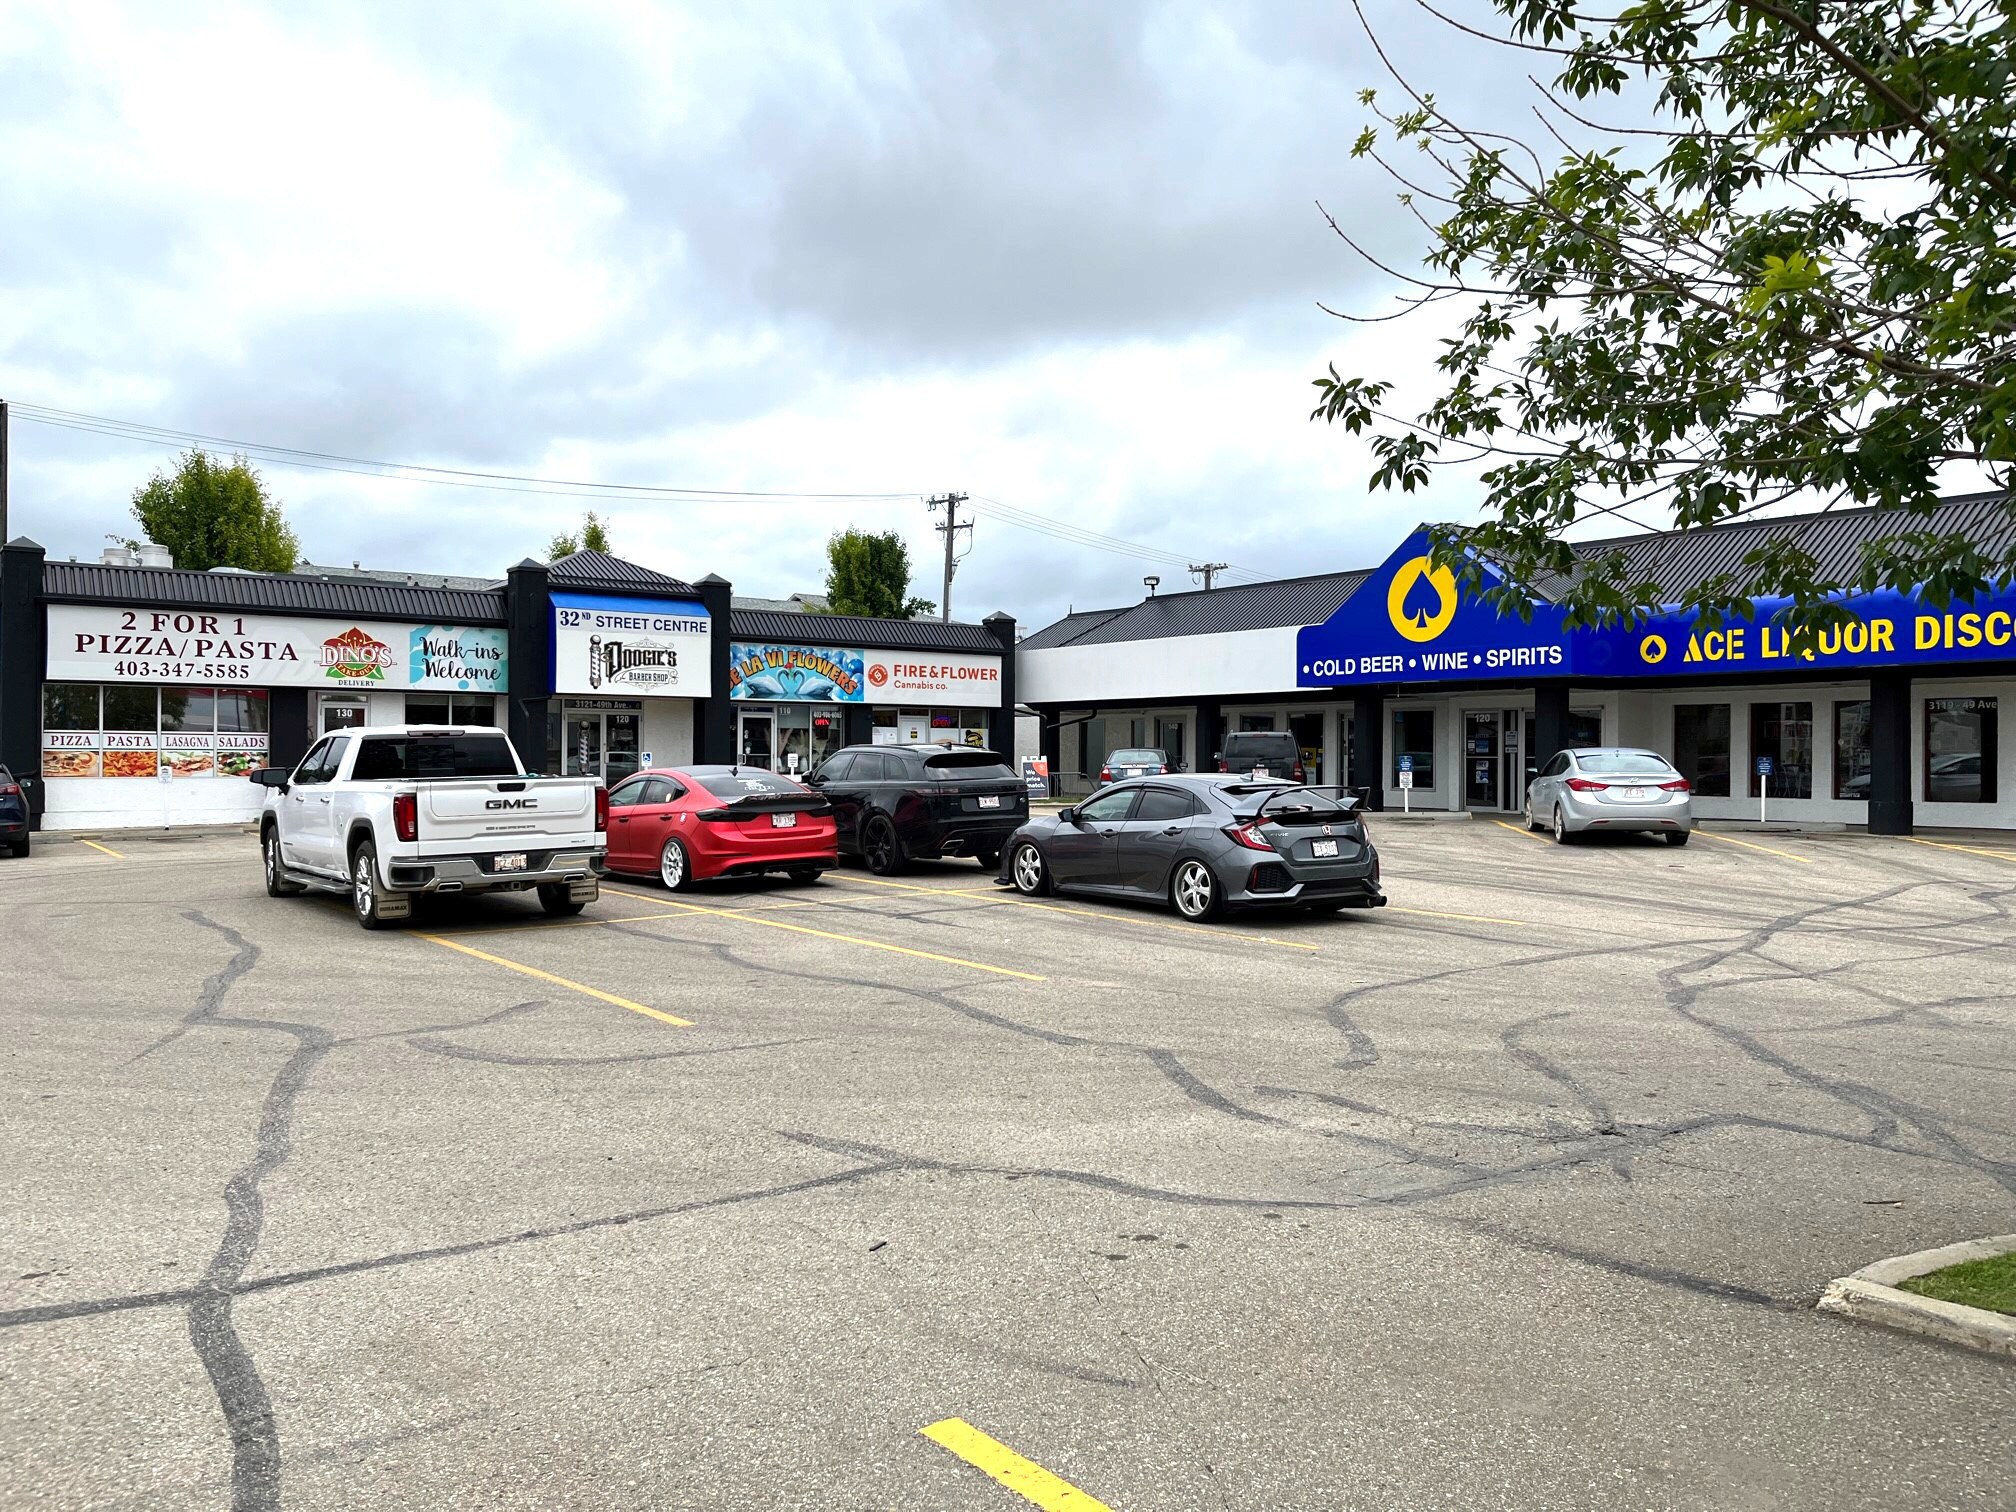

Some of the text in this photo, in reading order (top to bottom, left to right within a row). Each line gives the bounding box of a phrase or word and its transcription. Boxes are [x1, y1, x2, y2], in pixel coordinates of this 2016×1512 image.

[121, 611, 246, 636] 2 FOR 1
[596, 615, 650, 630] STREET
[653, 619, 708, 633] CENTRE
[1683, 627, 1745, 662] ACE
[1914, 611, 2016, 650] DISC
[75, 634, 299, 661] PIZZA/PASTA
[319, 644, 393, 668] DINO'S
[419, 636, 504, 660] Walk-ins
[421, 657, 502, 680] Welcome
[1312, 645, 1563, 676] COLD BEER WINE SPIRITS
[114, 661, 250, 679] 403-347-5585
[740, 655, 765, 678] LA
[764, 651, 784, 668] VI
[787, 651, 858, 695] FLOWERS
[893, 680, 948, 690] Cannabis co.
[336, 709, 353, 717] 130
[616, 715, 630, 723] 120
[1475, 714, 1491, 723] 120
[50, 735, 93, 746] PIZZA
[107, 735, 152, 747] PASTA
[165, 736, 210, 748] LASAGNA
[218, 736, 265, 748] SALADS
[485, 799, 538, 809] GMC
